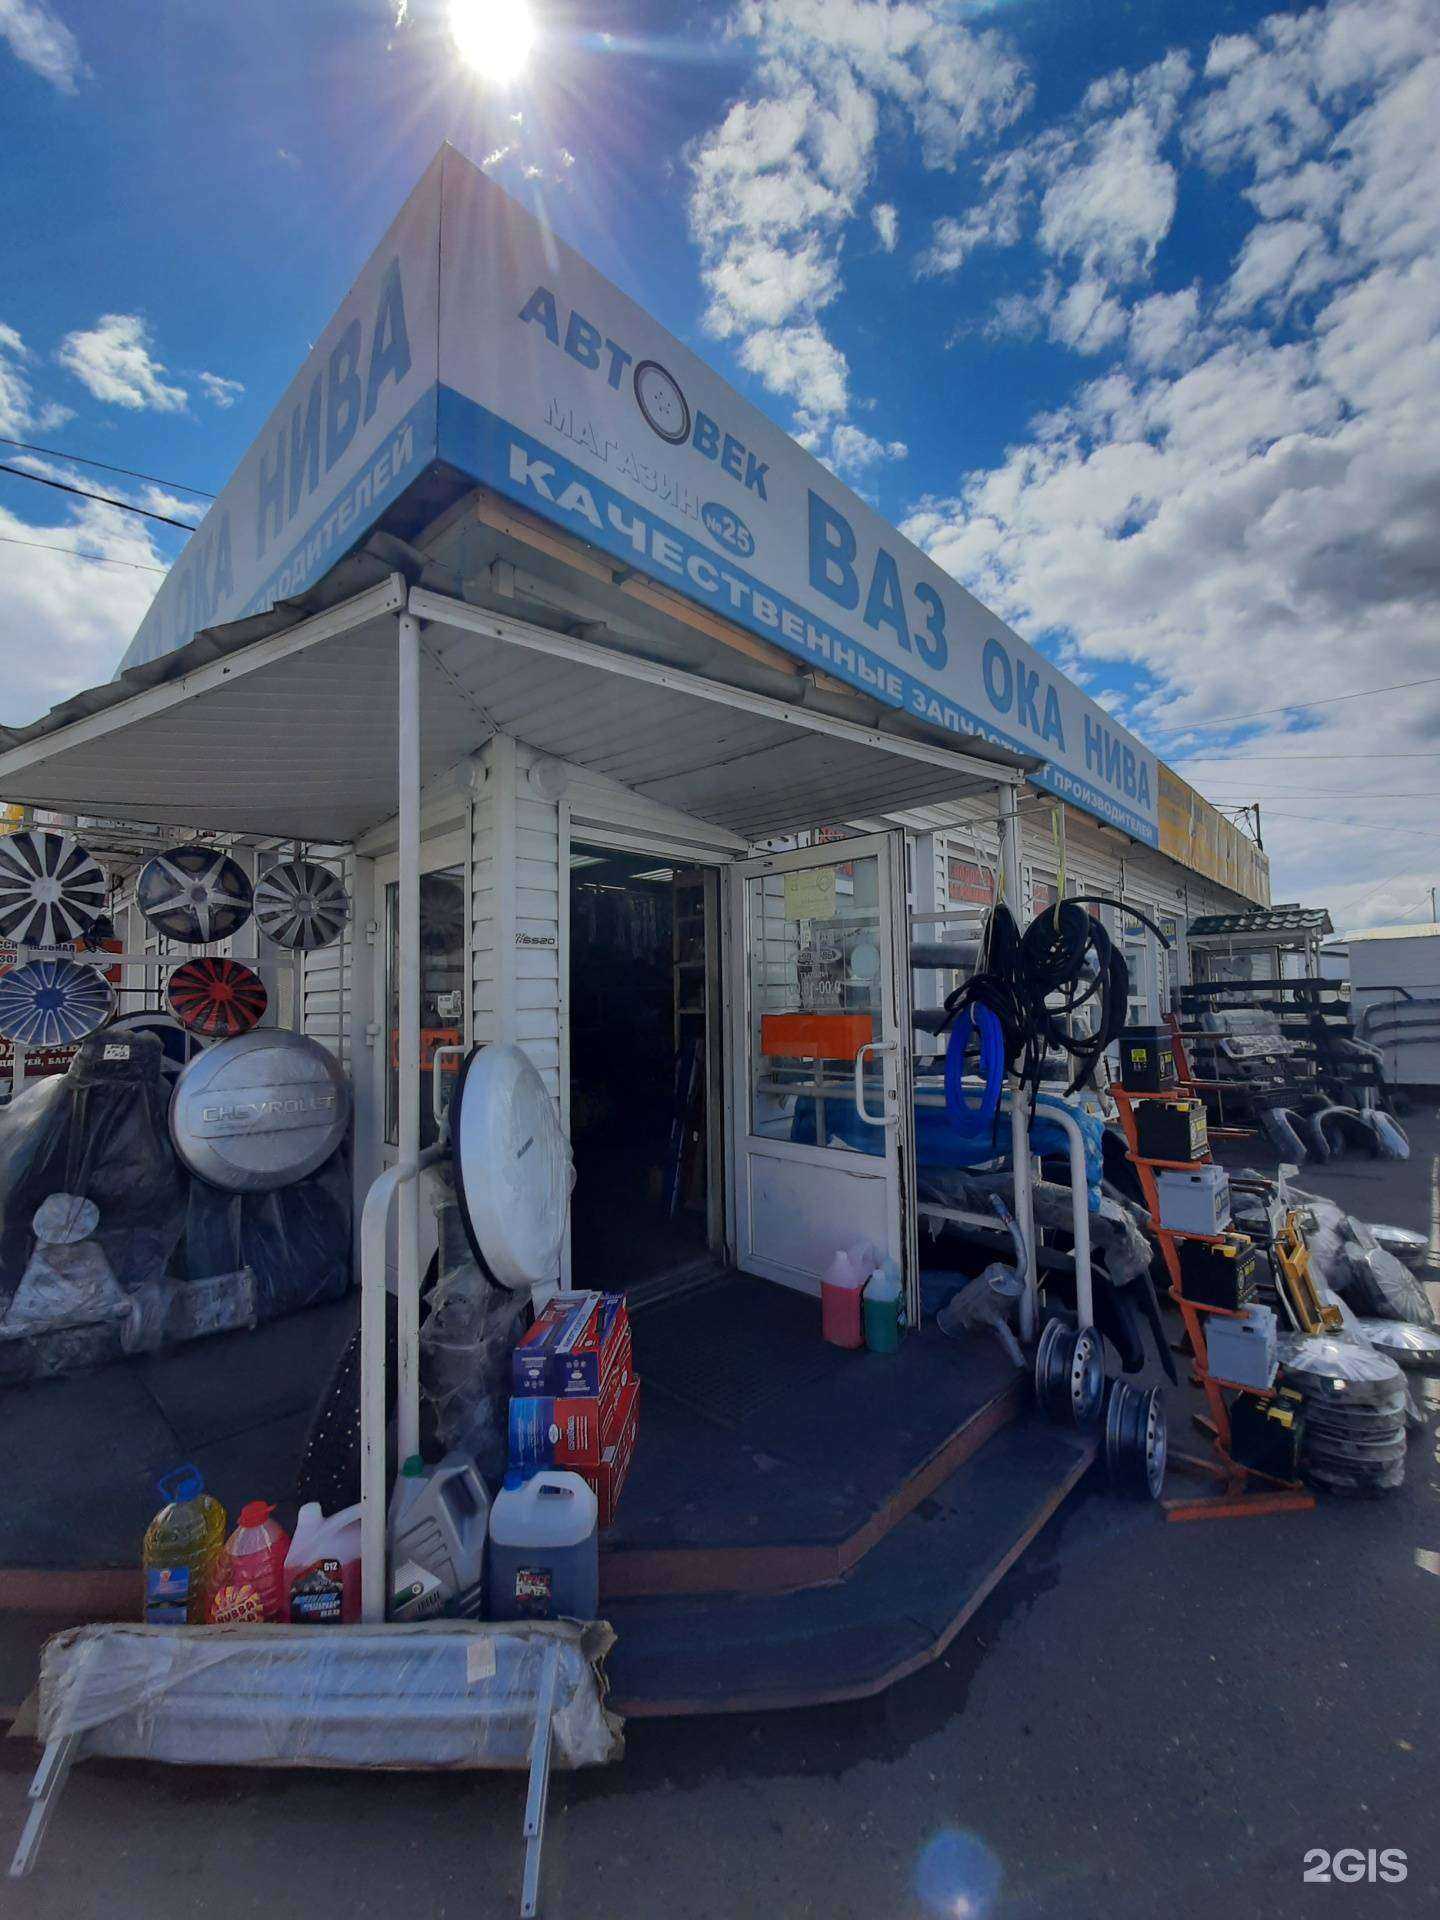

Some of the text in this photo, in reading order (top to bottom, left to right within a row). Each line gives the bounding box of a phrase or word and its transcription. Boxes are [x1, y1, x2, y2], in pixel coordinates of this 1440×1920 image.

[257, 254, 411, 560] НИВА
[544, 398, 751, 552] МАГАЗИН №25
[509, 443, 903, 700] КАЧЕСТВЕННЫЕ
[1053, 771, 1153, 840] ПРОИЗВОДИТЕЛЕЙ
[808, 488, 1151, 810] ВАЗ ОКА НИВА
[203, 1096, 336, 1122] CHEVROLET
